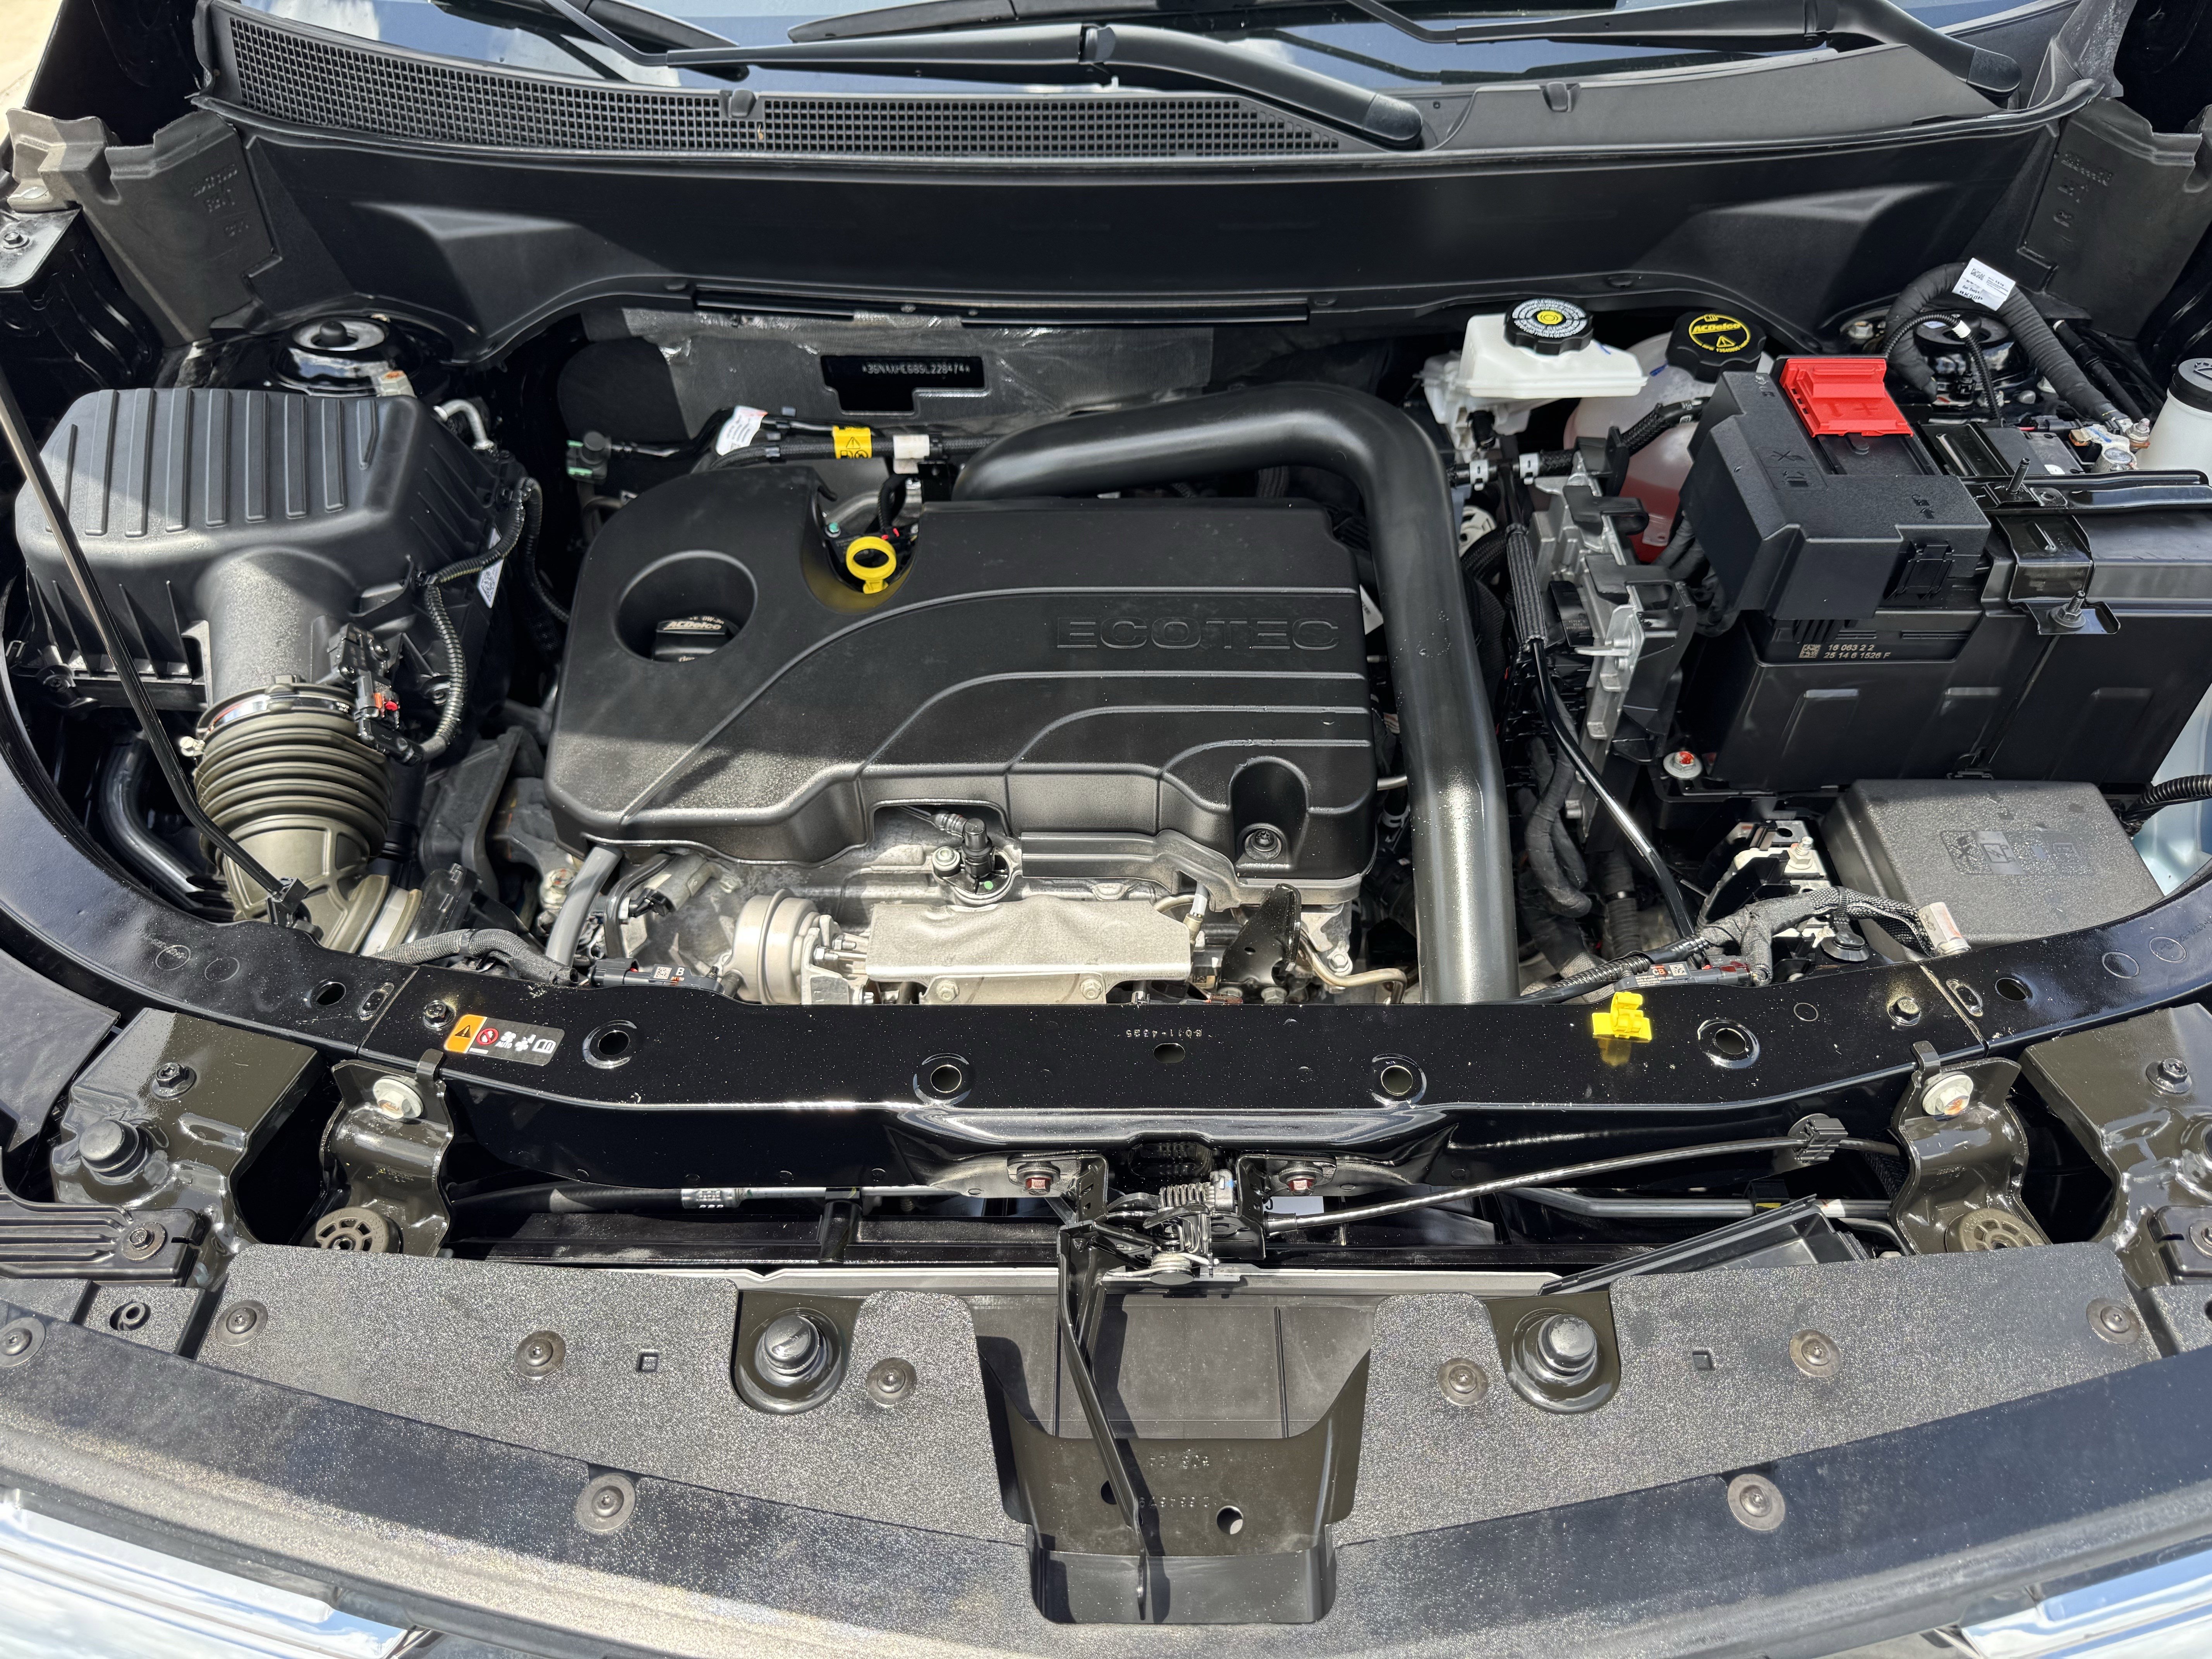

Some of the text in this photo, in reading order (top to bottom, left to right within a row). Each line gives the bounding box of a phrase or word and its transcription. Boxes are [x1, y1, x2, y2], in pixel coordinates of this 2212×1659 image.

[1692, 323, 1741, 334] ACDelco
[663, 621, 722, 630] ACDelco
[1057, 617, 1339, 650] ECOTEC
[675, 967, 685, 976] B
